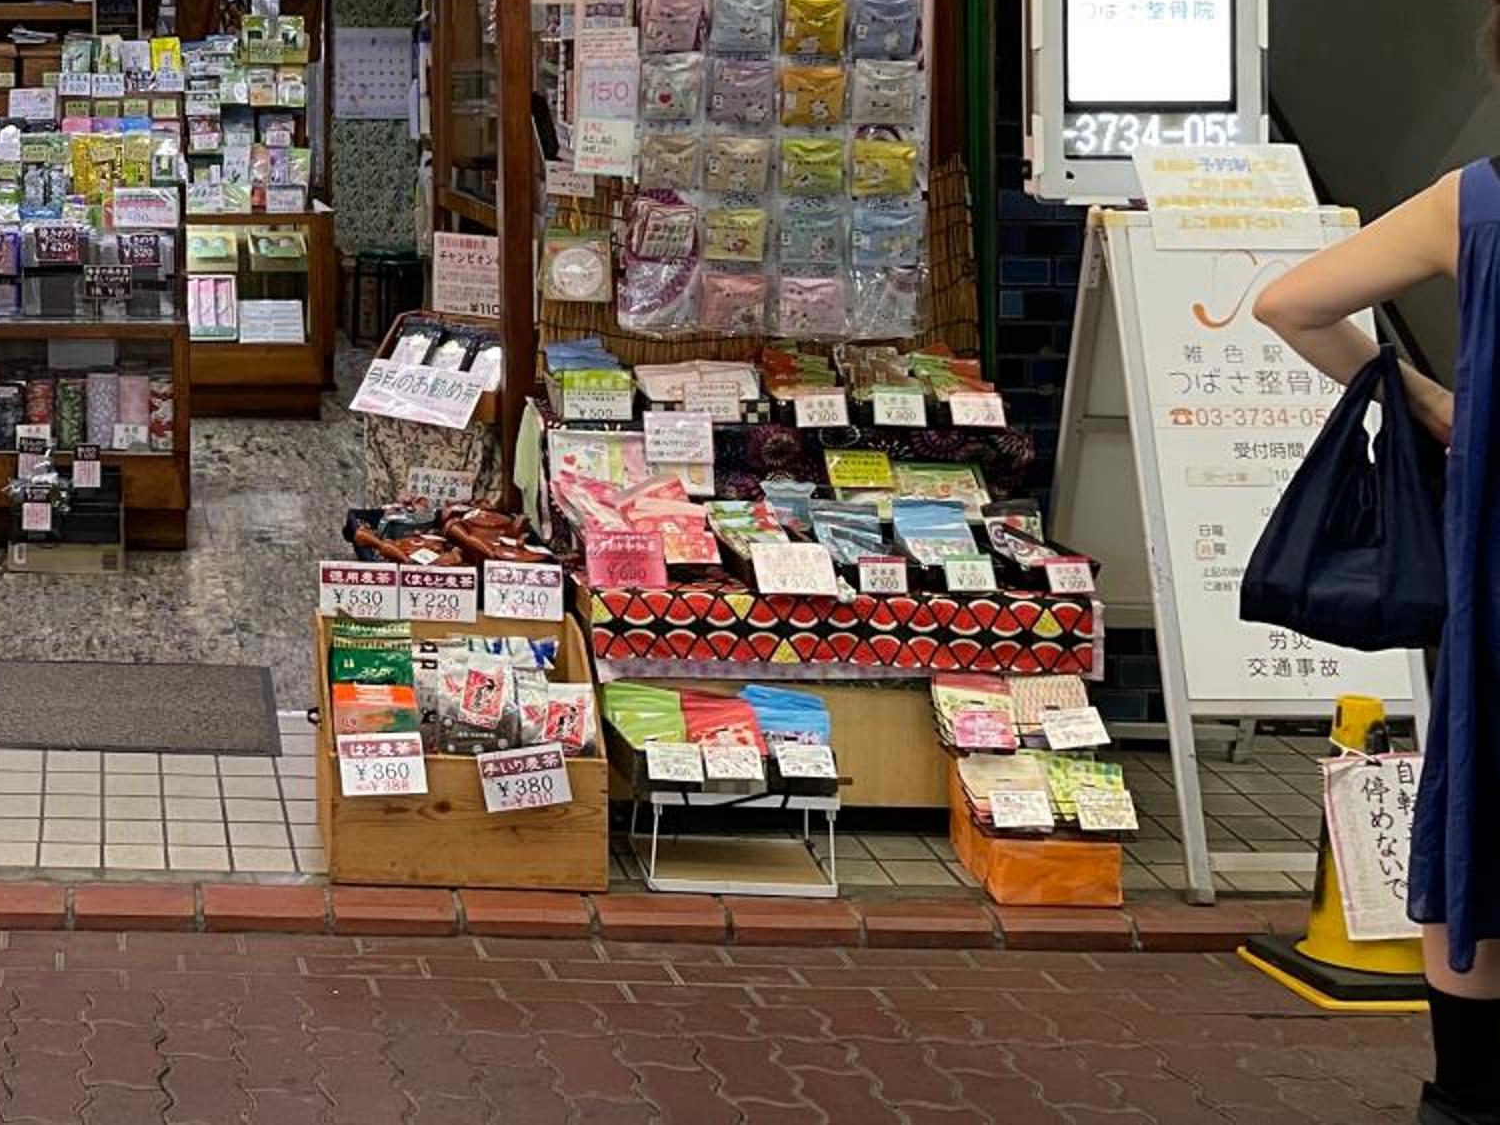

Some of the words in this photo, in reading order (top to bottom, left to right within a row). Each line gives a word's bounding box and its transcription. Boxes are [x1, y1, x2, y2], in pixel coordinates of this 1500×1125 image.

[1233, 441, 1305, 461] 受付時間
[1247, 657, 1341, 677] 交通事故
[355, 762, 410, 780] ¥360
